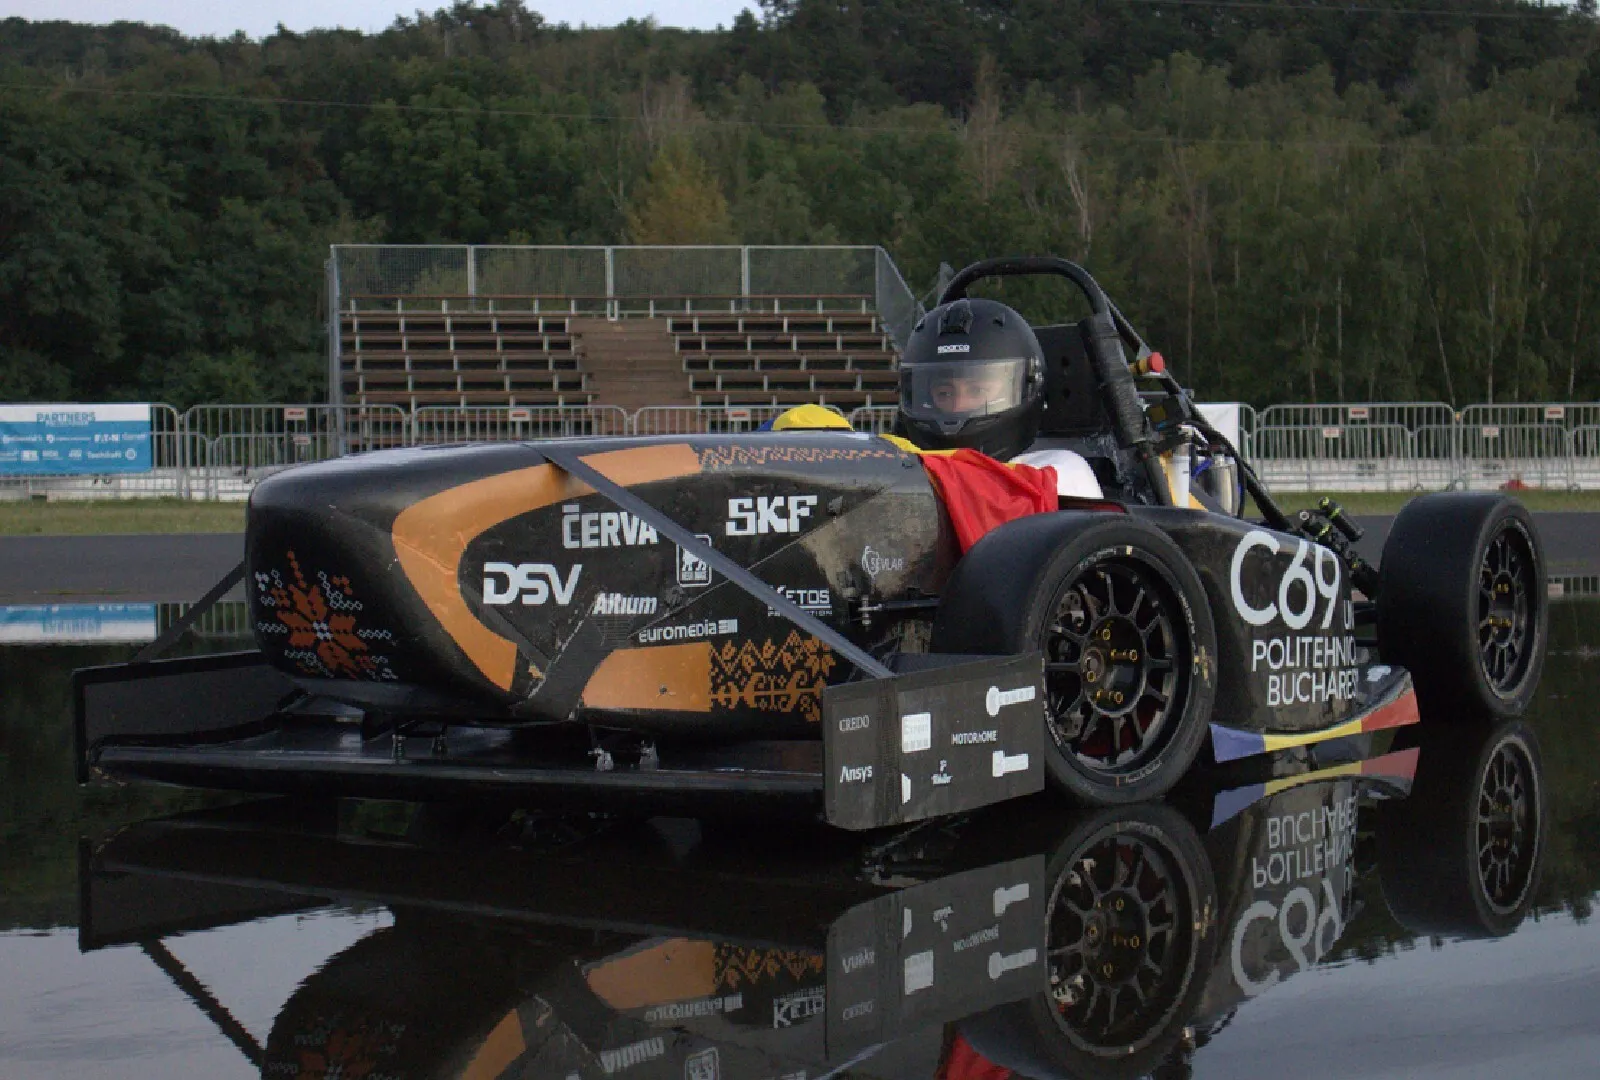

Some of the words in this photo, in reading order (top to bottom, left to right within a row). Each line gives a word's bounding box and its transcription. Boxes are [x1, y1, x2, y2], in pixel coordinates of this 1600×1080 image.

[36, 412, 96, 424] PARTNERS
[726, 496, 818, 536] SKF
[483, 562, 582, 604] DSV
[1231, 530, 1340, 630] C69
[592, 593, 657, 615] Altium
[839, 765, 873, 783] Ansys
